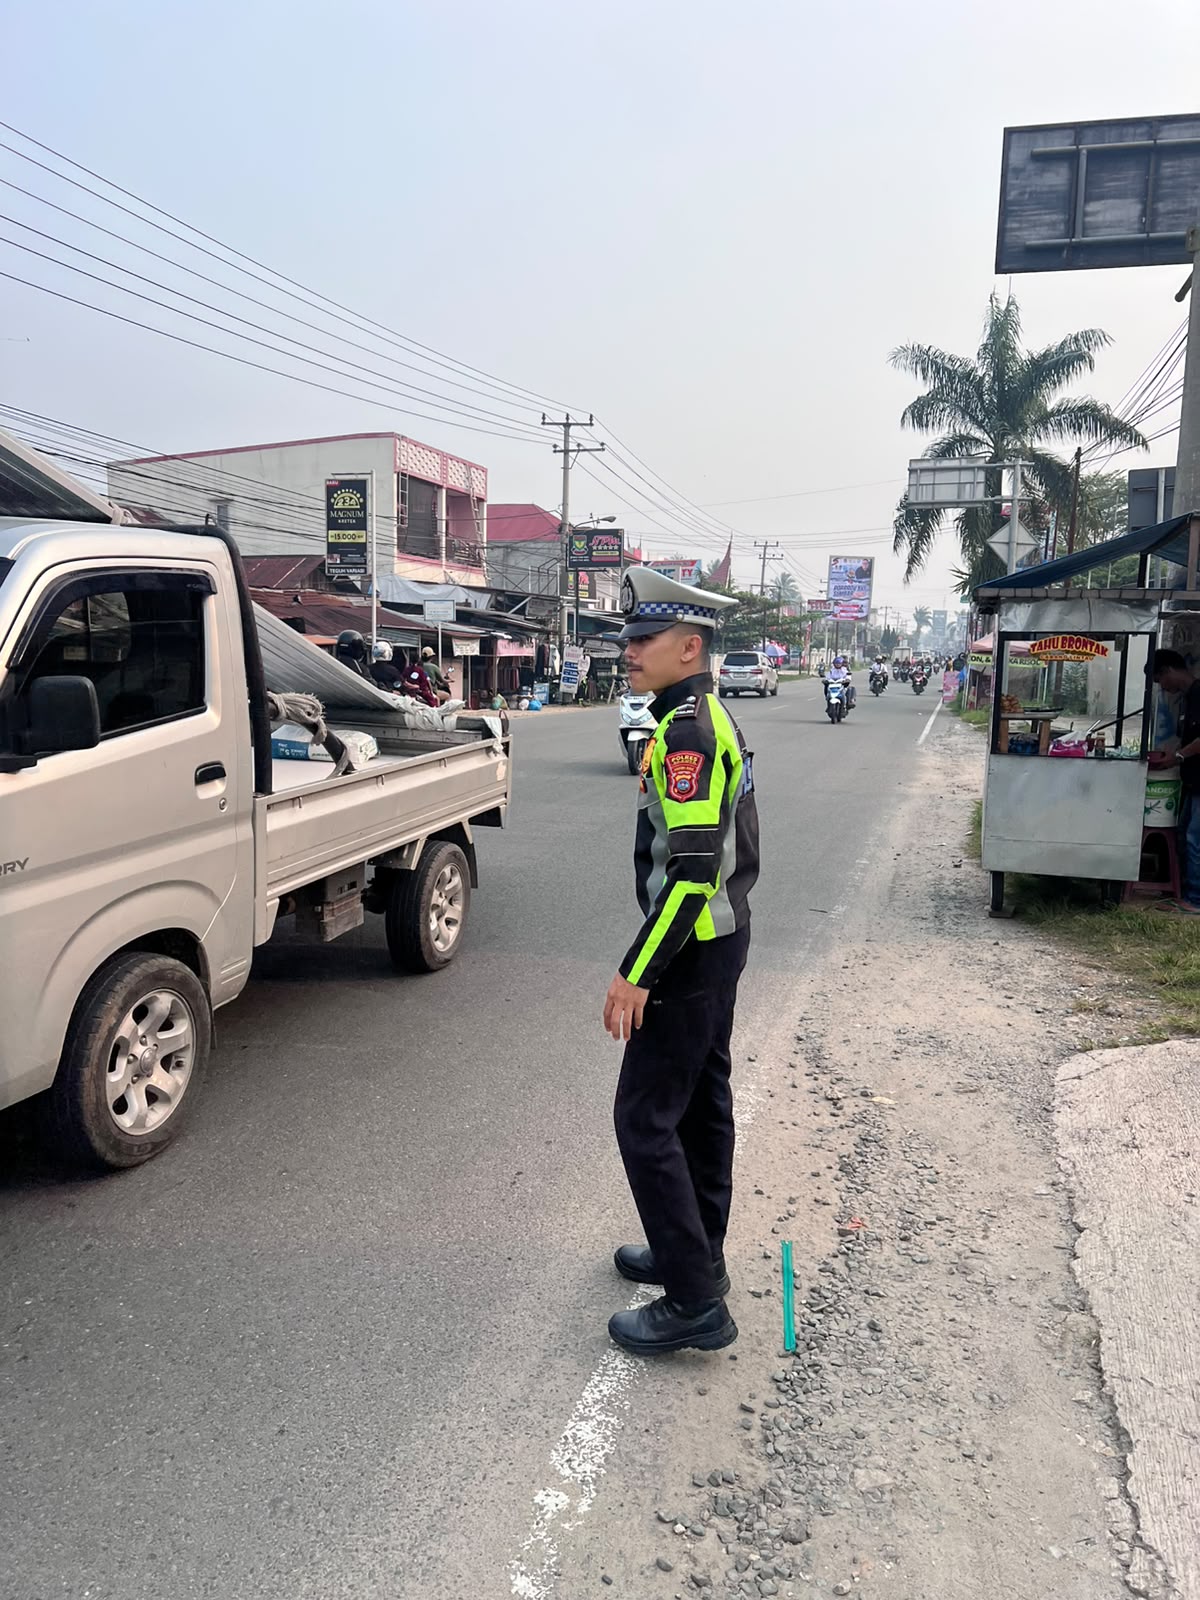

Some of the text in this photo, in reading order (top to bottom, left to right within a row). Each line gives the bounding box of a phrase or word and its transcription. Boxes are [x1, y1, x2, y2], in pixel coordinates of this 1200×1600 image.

[337, 496, 357, 506] 234
[330, 510, 364, 518] MAGNUM
[1030, 636, 1109, 657] TAHU BRONTAK
[671, 755, 698, 764] POLRES
